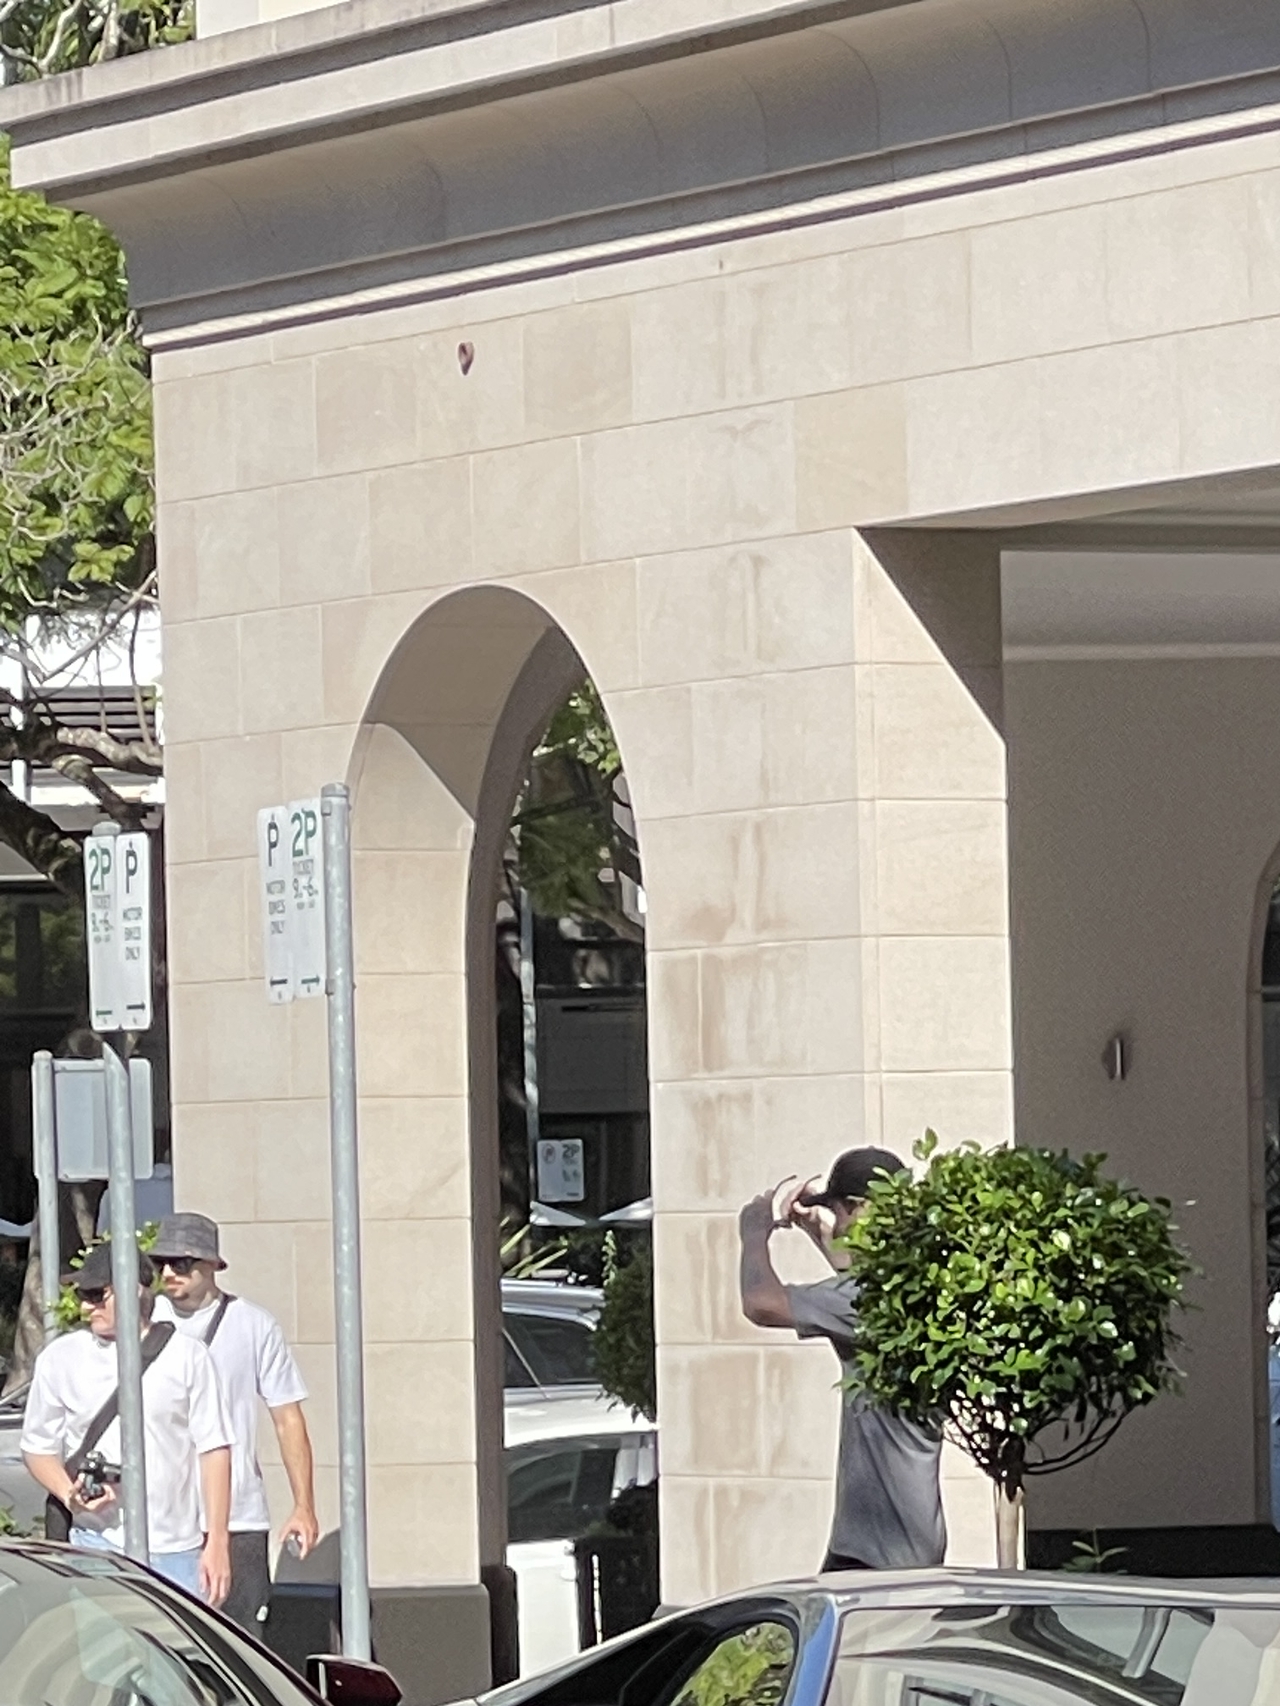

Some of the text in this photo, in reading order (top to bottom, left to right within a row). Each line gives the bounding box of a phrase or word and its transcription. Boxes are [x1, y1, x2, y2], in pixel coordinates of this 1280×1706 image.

[268, 821, 279, 867] P
[290, 809, 317, 858] 2P
[88, 847, 112, 893] 2P
[125, 849, 138, 894] P
